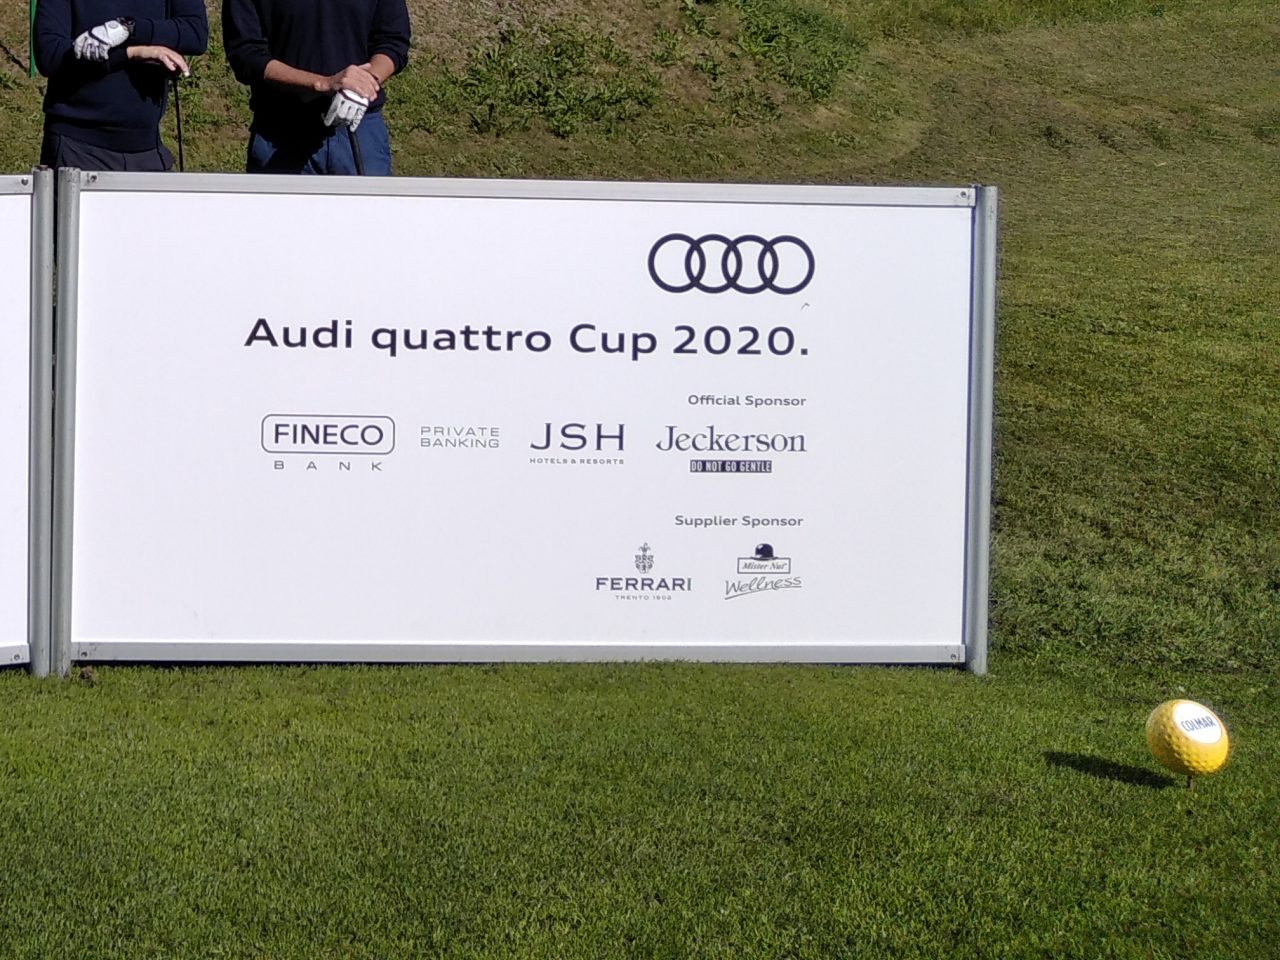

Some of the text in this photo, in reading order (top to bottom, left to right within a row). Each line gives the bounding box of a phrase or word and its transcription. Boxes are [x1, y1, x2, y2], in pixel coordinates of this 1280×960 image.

[245, 319, 808, 362] Audi quattro Cup 2020.
[687, 394, 807, 409] Official Sponsor
[274, 423, 384, 446] FINECO
[420, 426, 500, 437] PRIVATE
[529, 422, 625, 451] JSH
[655, 425, 807, 452] Jeckerson
[420, 438, 500, 449] BANKING
[273, 460, 382, 472] BANK
[529, 457, 568, 465] HOTELS
[579, 458, 625, 466] RESORTS
[691, 460, 771, 472] DO NOT GO GENTLE
[674, 515, 804, 529] Supplier Sponsor
[742, 561, 768, 570] Mister
[596, 577, 692, 591] FERRARI
[725, 576, 802, 595] Wellness
[1181, 716, 1216, 731] COLMAR
